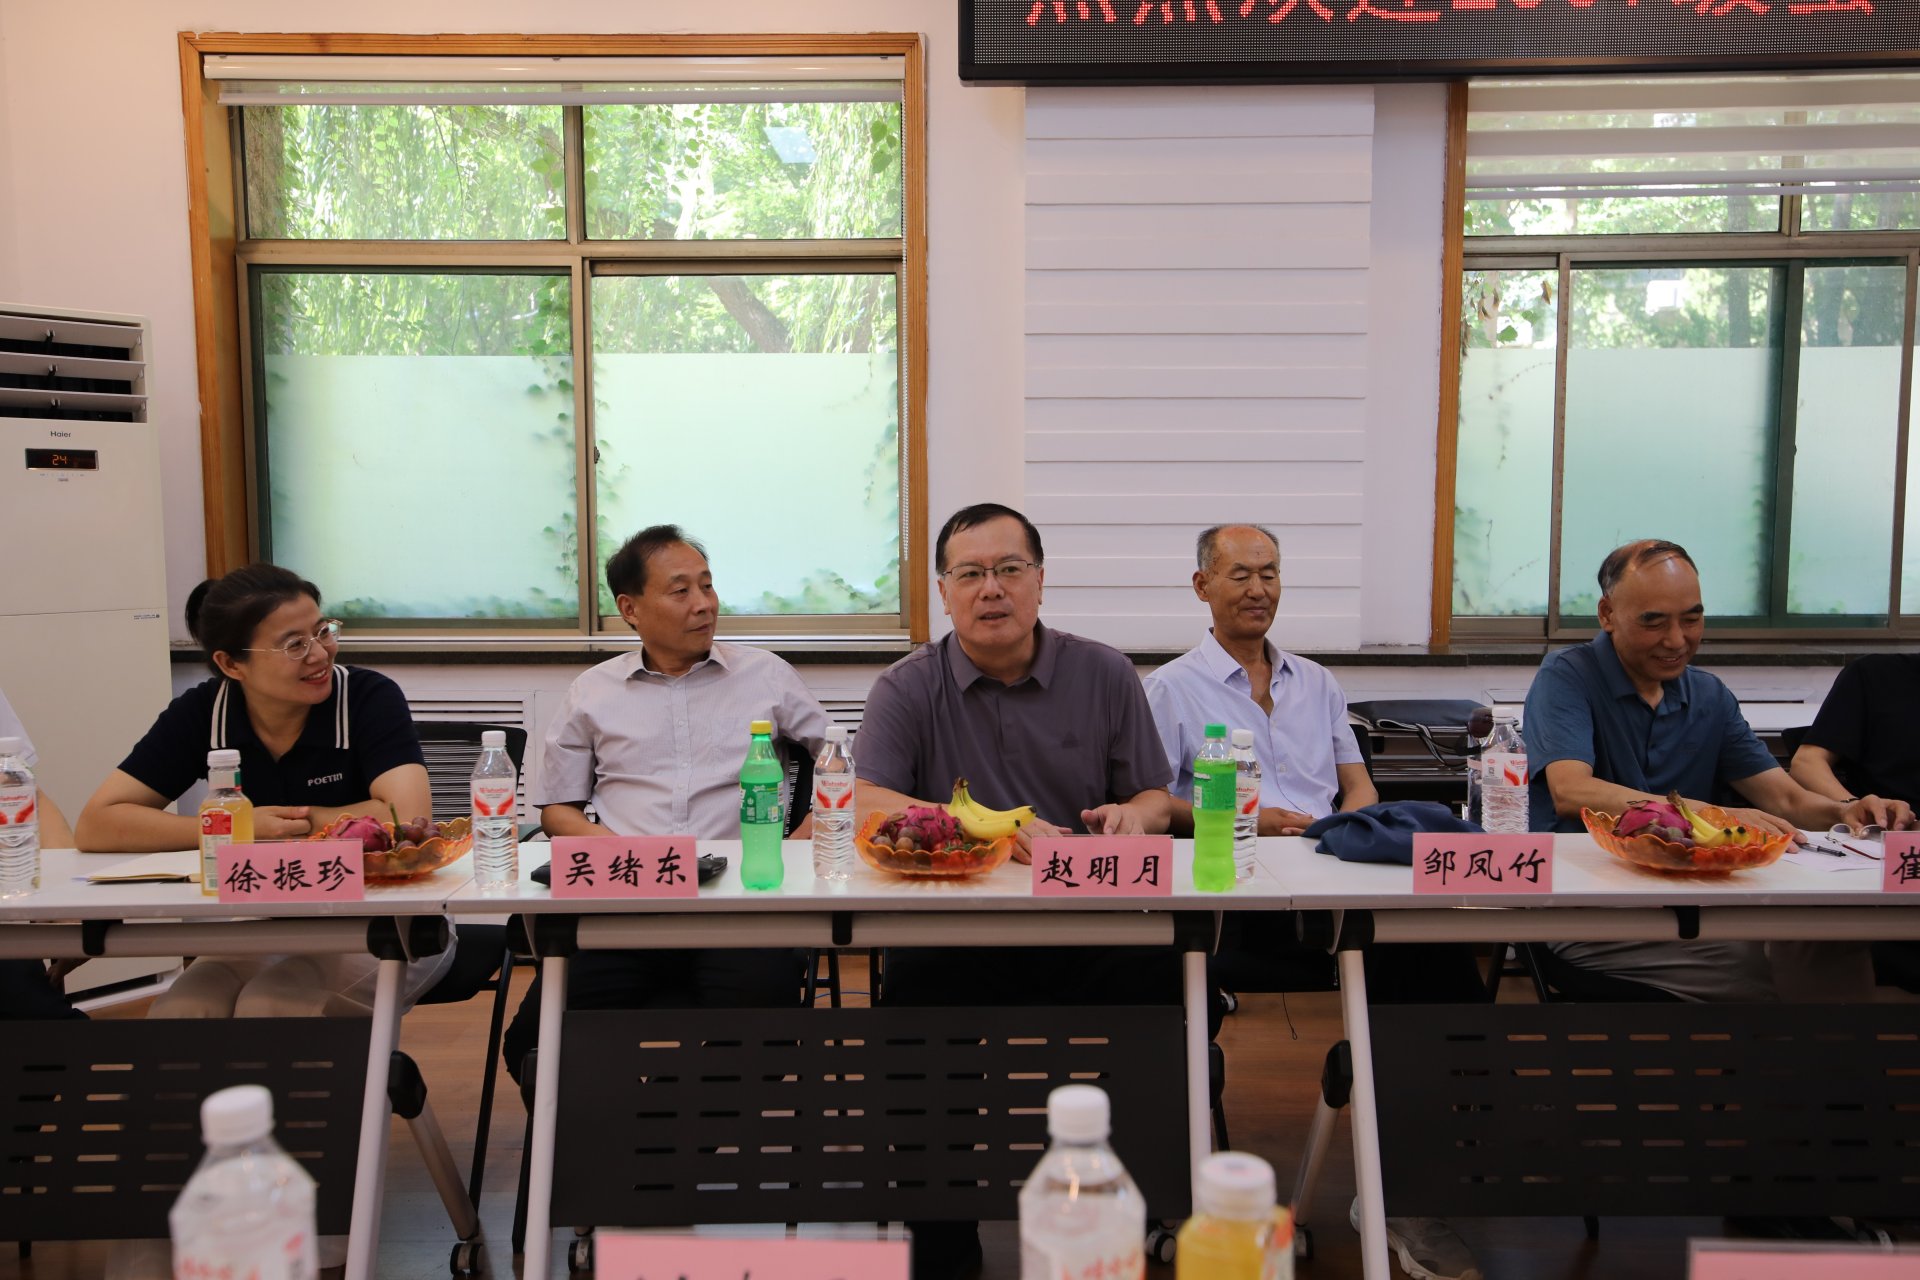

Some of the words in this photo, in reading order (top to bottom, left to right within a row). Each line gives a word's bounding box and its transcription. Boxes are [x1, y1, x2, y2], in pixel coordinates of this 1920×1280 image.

[50, 430, 72, 438] Haier
[52, 454, 67, 466] 24
[224, 854, 356, 893] 徐振珍
[565, 846, 687, 887] 吴绪东
[1040, 850, 1160, 888] 赵明月
[1423, 848, 1546, 886] 邹凤竹
